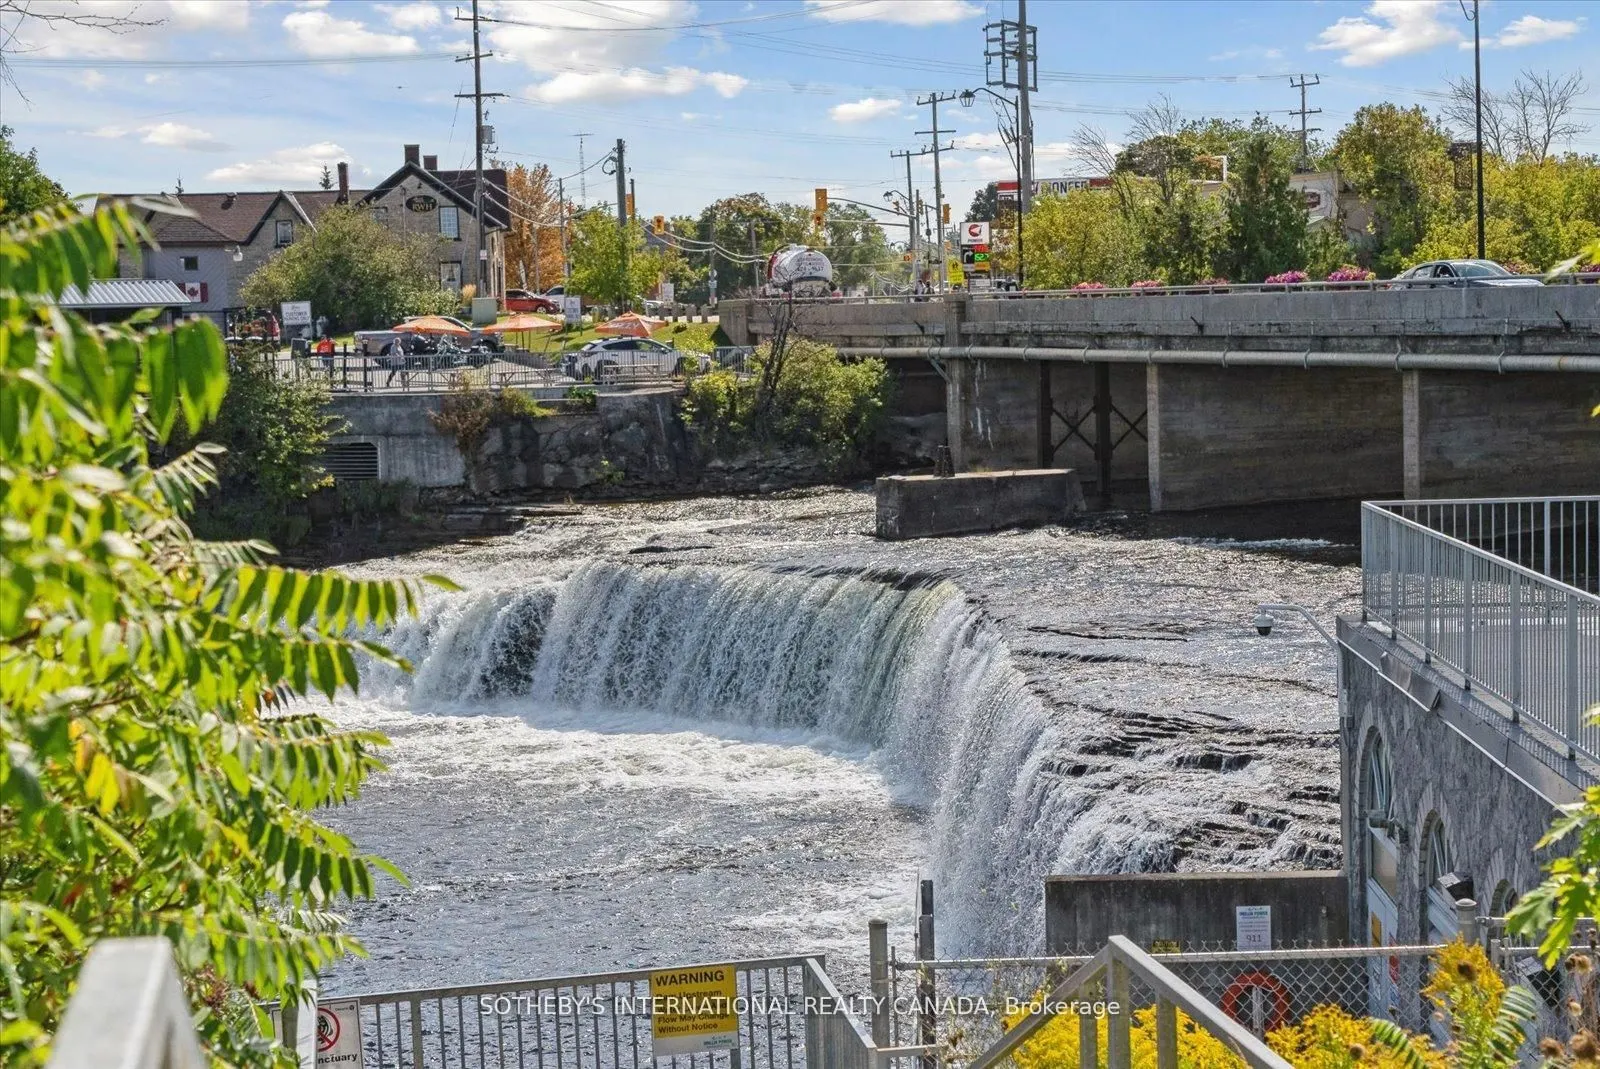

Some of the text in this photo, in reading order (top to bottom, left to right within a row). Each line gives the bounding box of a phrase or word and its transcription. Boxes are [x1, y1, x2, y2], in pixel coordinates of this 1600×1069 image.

[1246, 934, 1262, 942] 911
[655, 970, 725, 986] WARNING
[657, 1015, 677, 1024] Flow
[680, 1013, 696, 1022] May
[658, 1022, 718, 1033] Without Notice
[317, 1053, 358, 1065] nctuary
